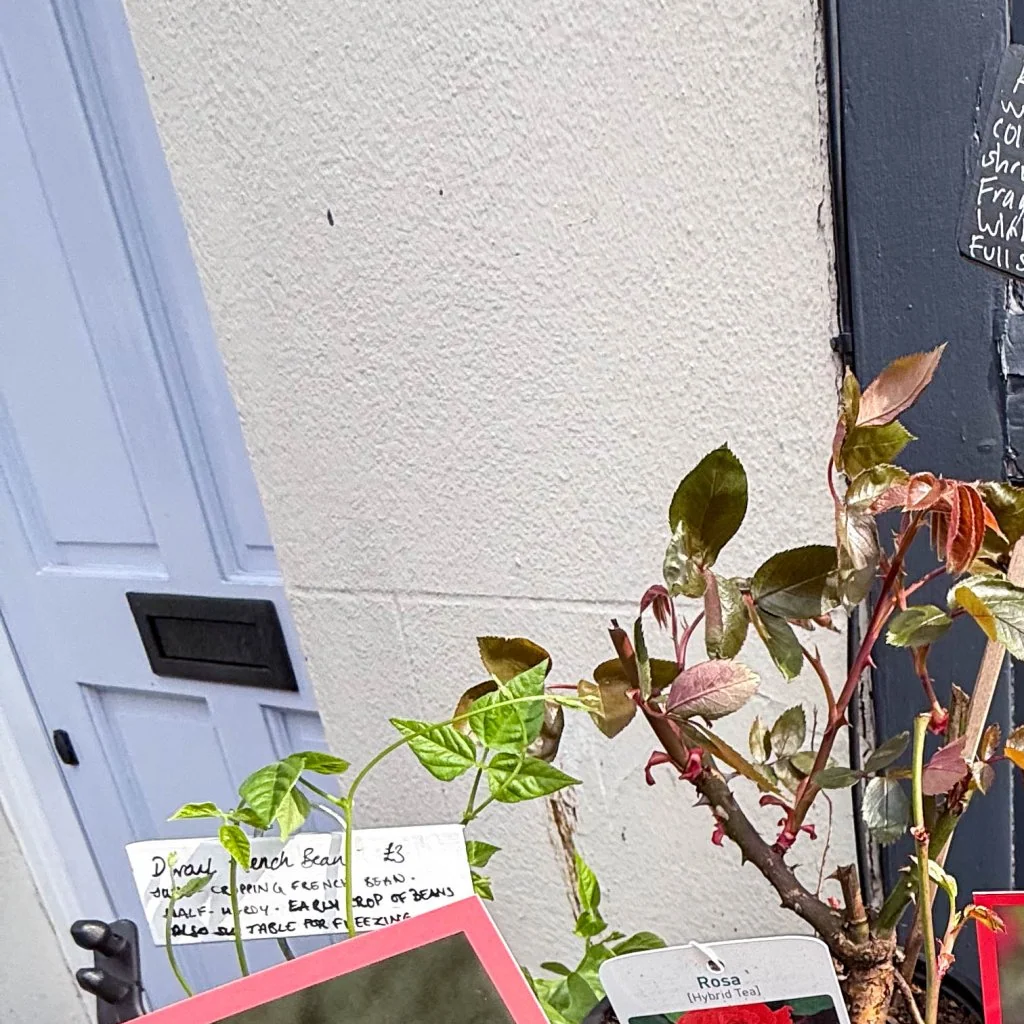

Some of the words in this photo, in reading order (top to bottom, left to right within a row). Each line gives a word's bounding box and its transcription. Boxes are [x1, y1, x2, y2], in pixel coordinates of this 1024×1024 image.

[968, 234, 1010, 269] Full
[383, 842, 406, 863] £3
[211, 883, 287, 897] CRPPING
[697, 976, 741, 989] Rosa
